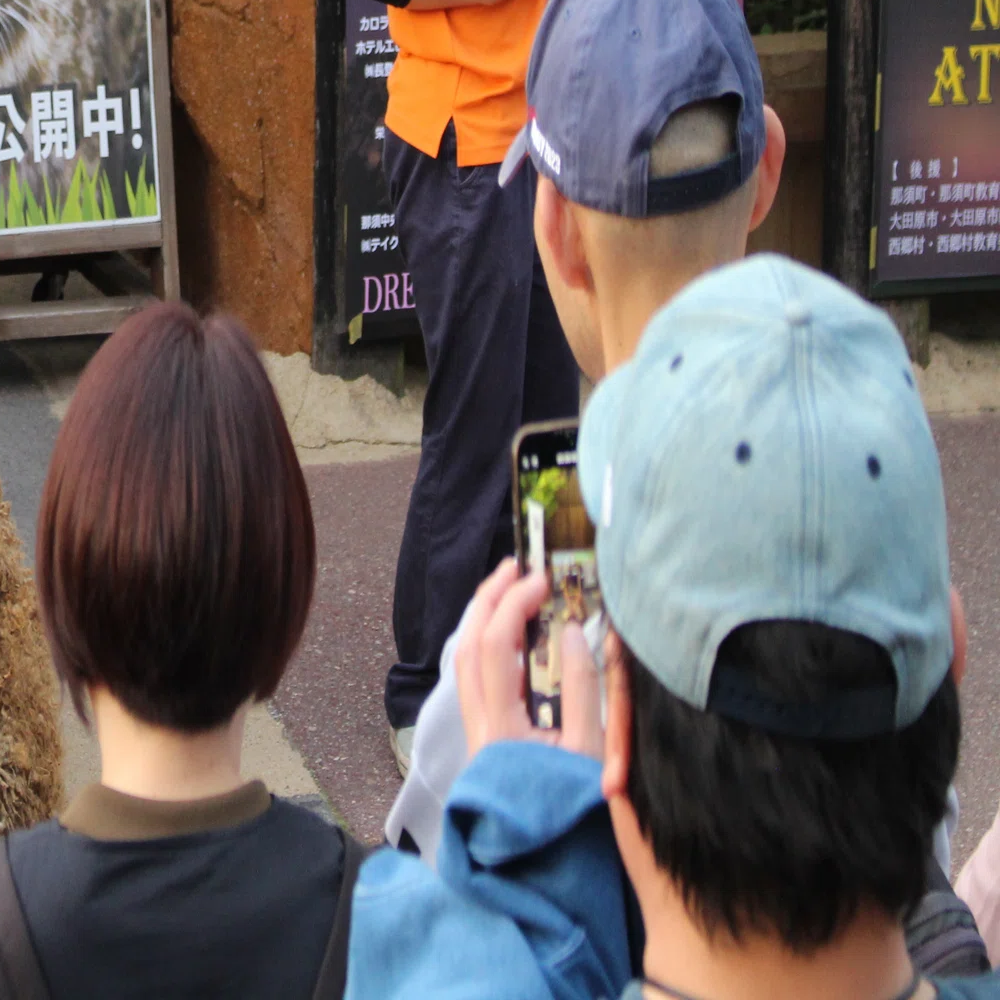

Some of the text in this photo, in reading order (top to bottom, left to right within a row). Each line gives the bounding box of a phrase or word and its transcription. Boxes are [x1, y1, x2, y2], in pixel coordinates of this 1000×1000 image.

[928, 44, 1000, 106] AT
[889, 207, 1000, 231] 大田原市・大田原市
[888, 231, 1000, 256] 西郷村・西郷村教育
